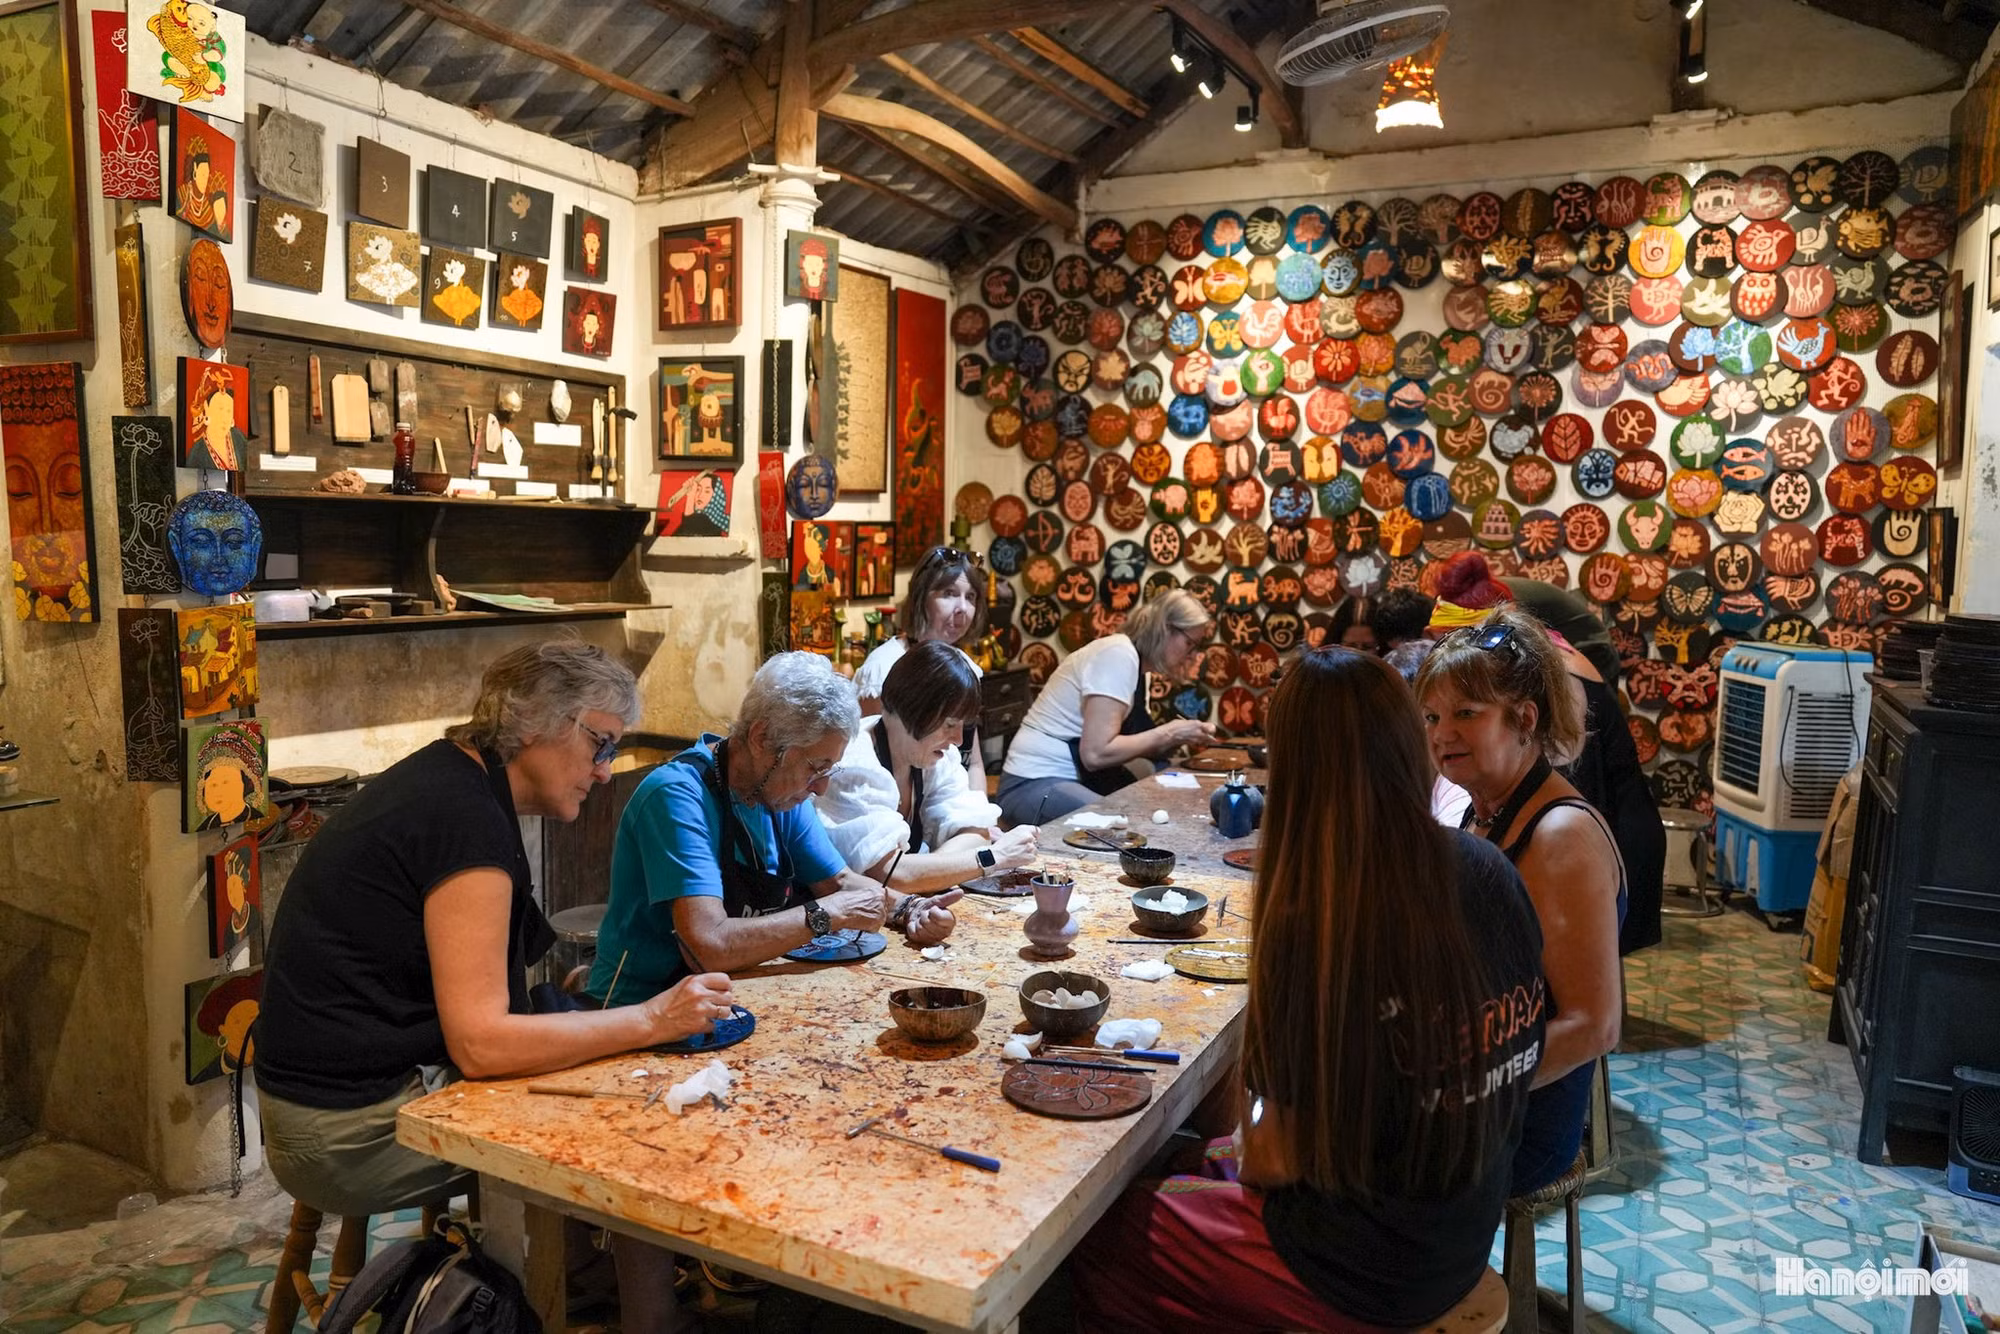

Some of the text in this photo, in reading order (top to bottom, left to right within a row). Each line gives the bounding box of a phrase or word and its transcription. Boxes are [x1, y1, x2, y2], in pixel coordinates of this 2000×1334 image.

[288, 151, 303, 174] 2
[381, 176, 389, 193] 3
[451, 204, 460, 218] 4
[511, 231, 518, 242] 5
[303, 260, 313, 272] 7
[434, 277, 441, 289] 9
[1421, 1040, 1540, 1113] VLUNTEER
